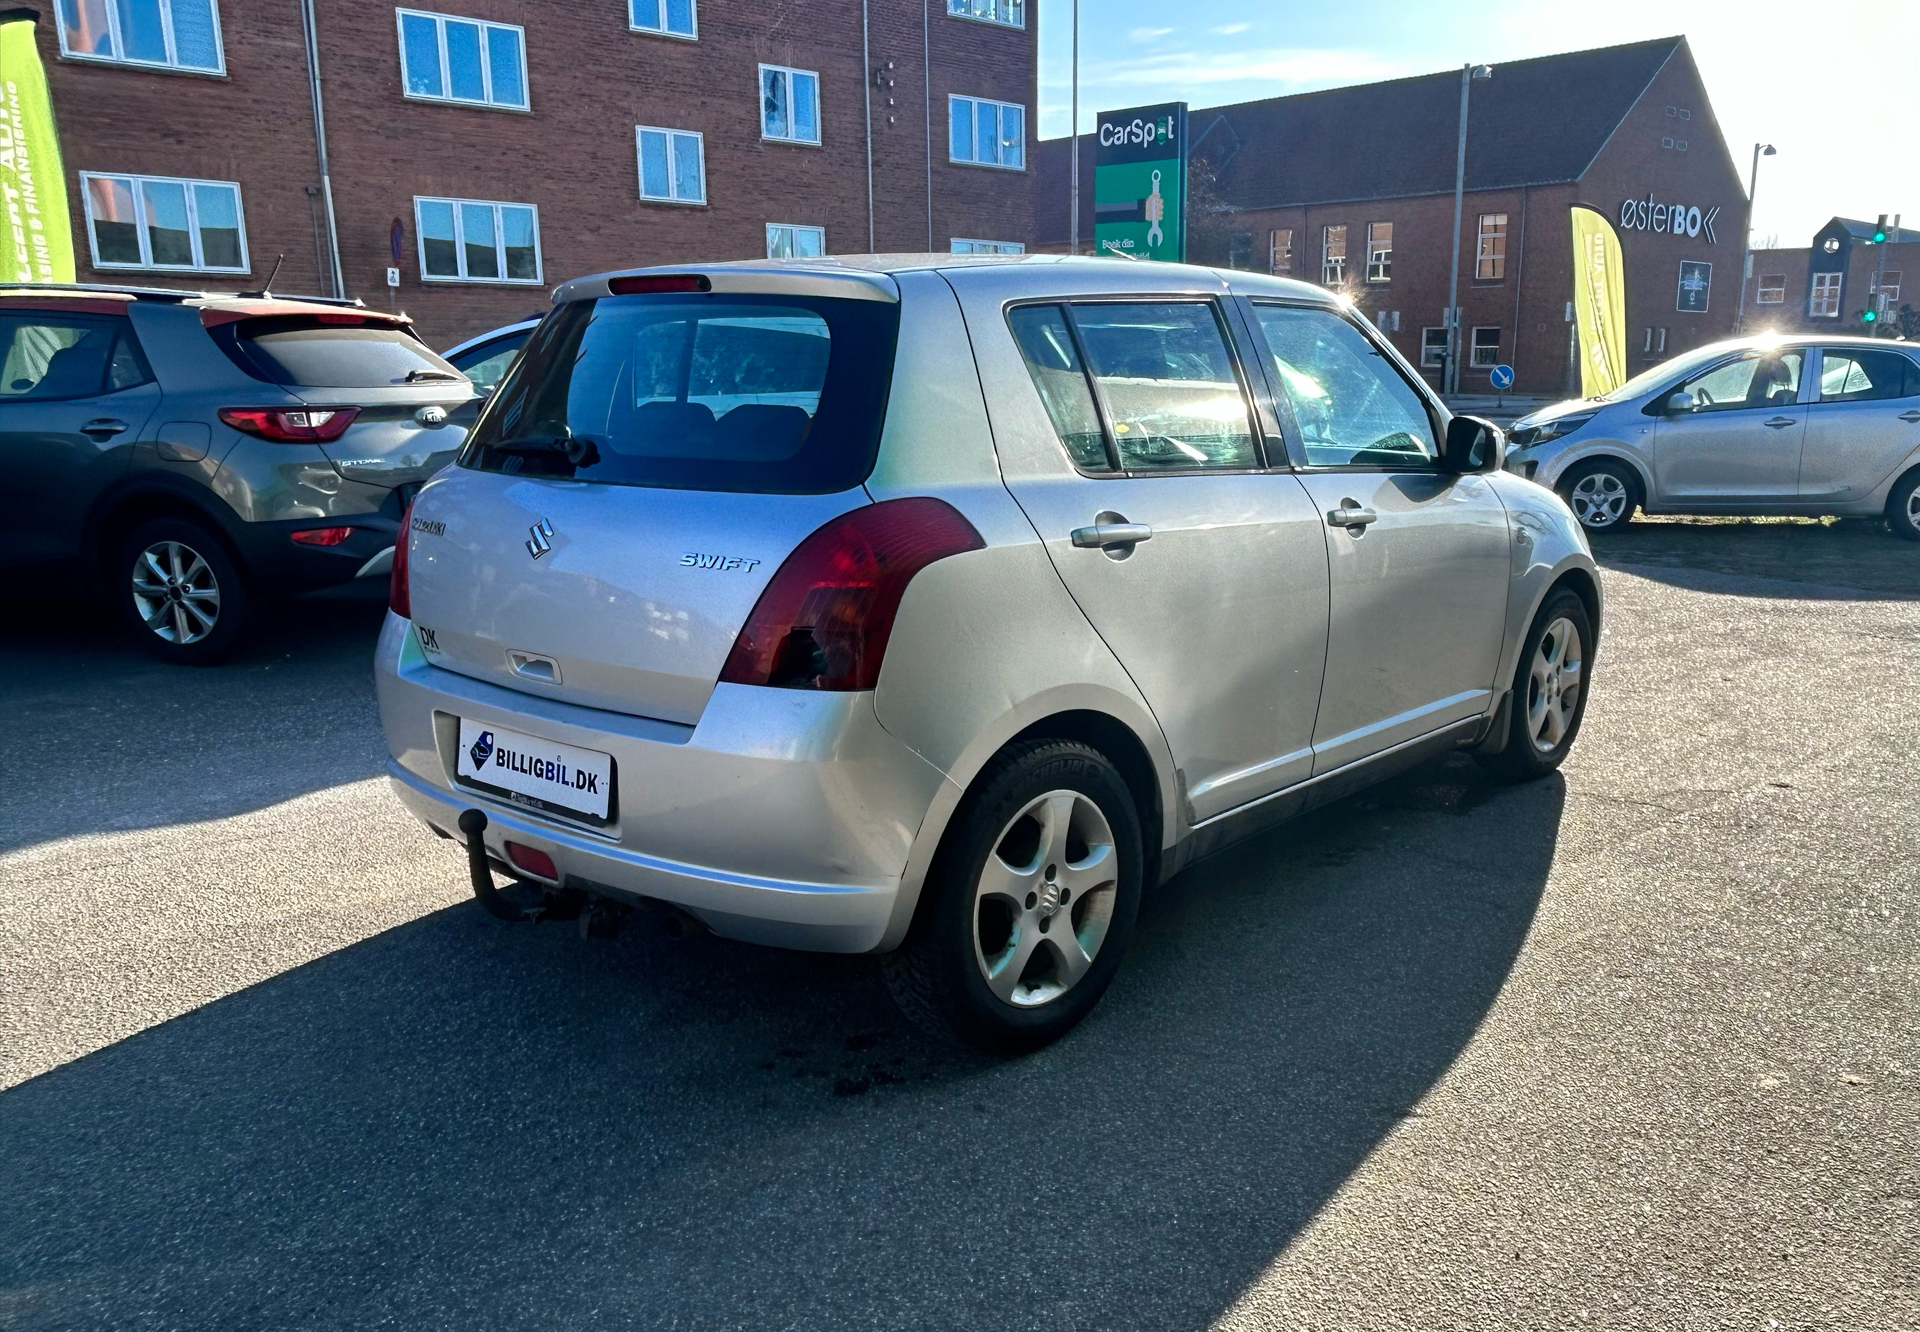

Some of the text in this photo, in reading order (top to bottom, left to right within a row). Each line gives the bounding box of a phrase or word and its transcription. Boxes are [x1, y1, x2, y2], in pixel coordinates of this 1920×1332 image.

[7, 80, 41, 214] FINANSIERING
[30, 214, 44, 231] &
[680, 552, 761, 573] SWIFT
[419, 626, 440, 650] DK
